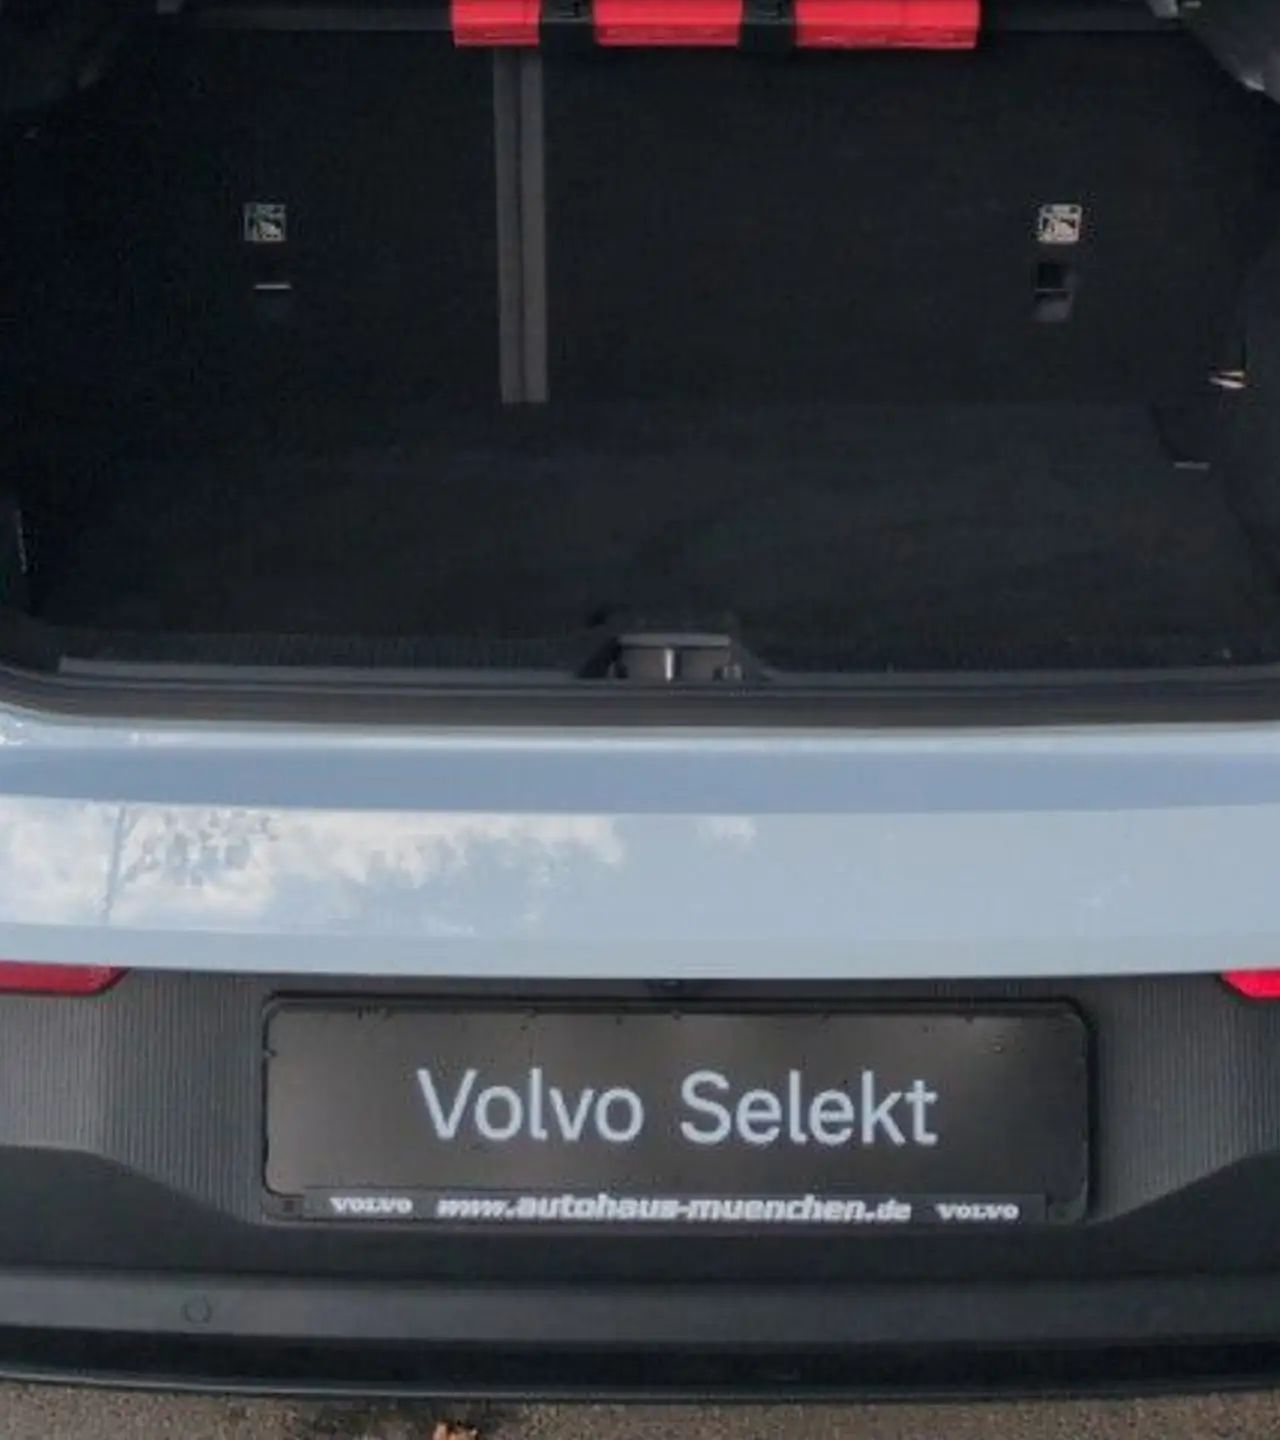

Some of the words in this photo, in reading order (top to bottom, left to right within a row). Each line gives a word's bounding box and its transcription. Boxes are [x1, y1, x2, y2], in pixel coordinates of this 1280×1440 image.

[417, 1067, 645, 1143] Volvo
[680, 1068, 938, 1146] Selekt
[329, 1195, 414, 1214] VOLVO
[435, 1192, 912, 1223] www.autohaus-muenchen.de
[934, 1202, 1020, 1221] VOLVO
